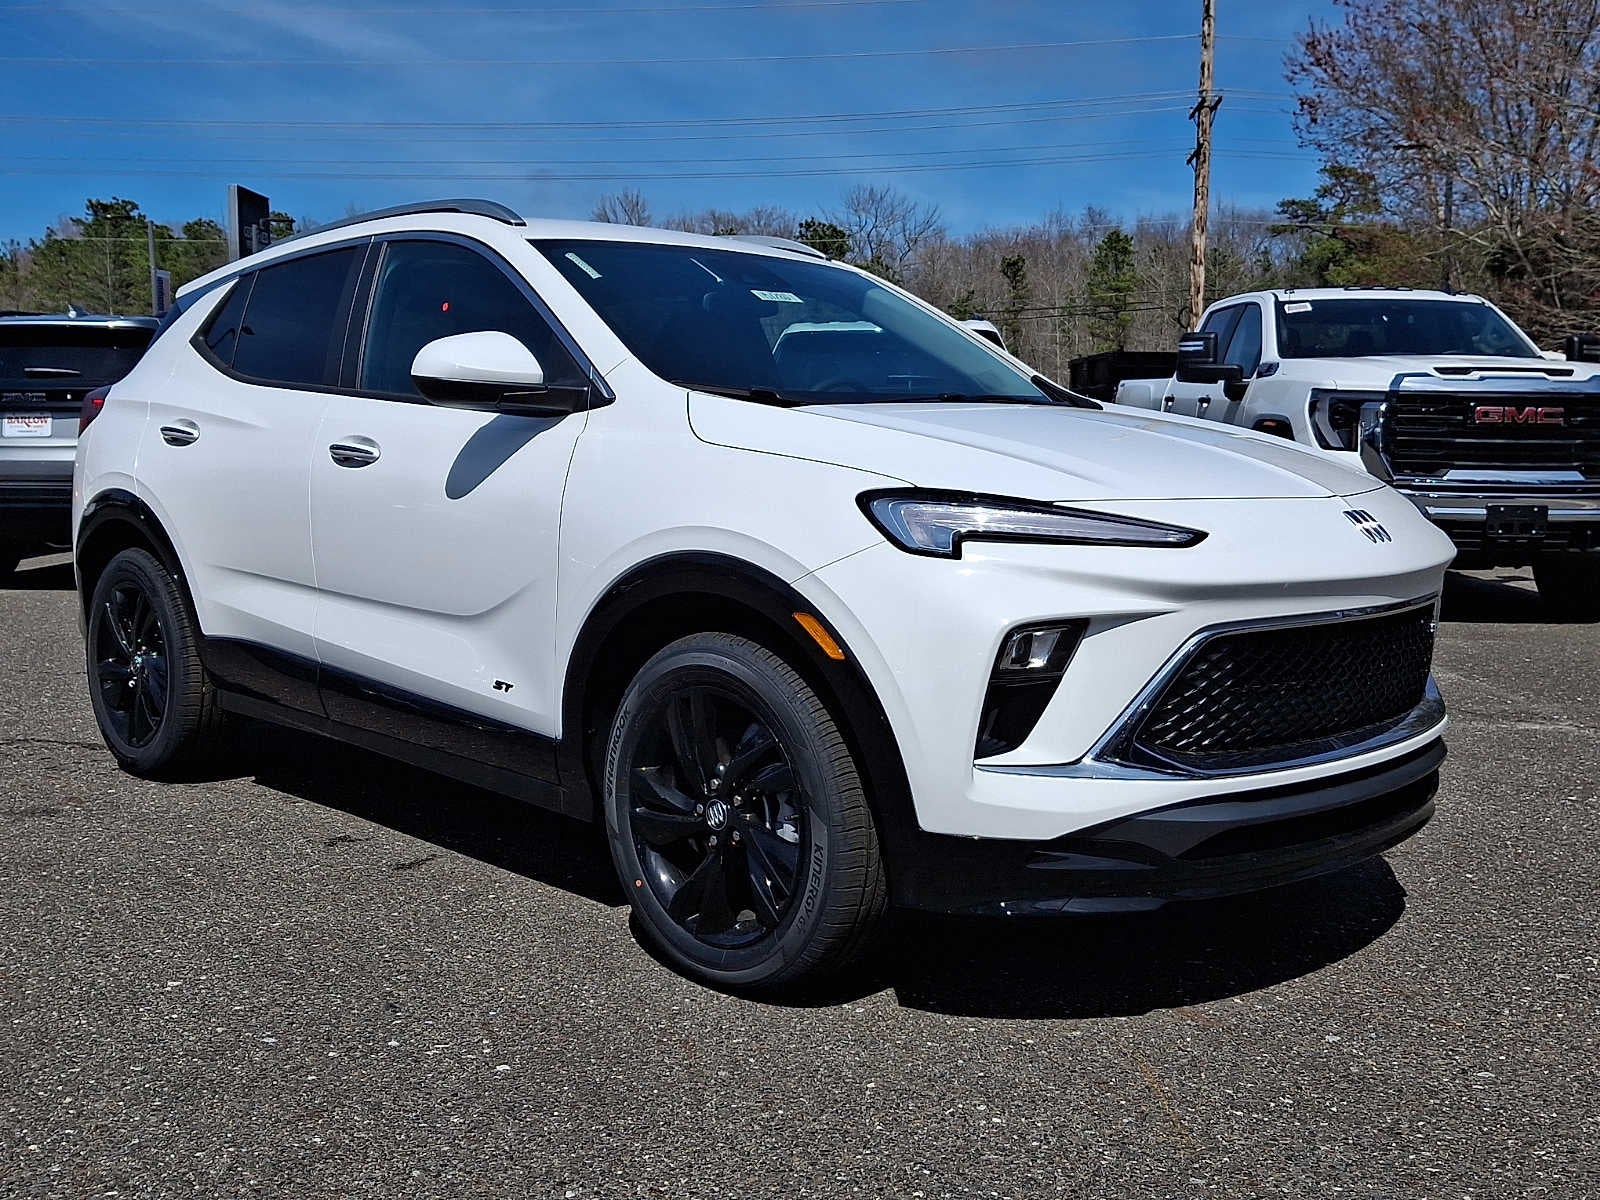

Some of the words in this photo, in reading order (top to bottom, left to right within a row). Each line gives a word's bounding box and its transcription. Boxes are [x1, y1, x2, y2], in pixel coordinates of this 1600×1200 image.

[7, 416, 49, 426] BARLOW
[1475, 406, 1564, 425] GMC
[492, 680, 514, 693] ST
[804, 844, 824, 918] KINERGY
